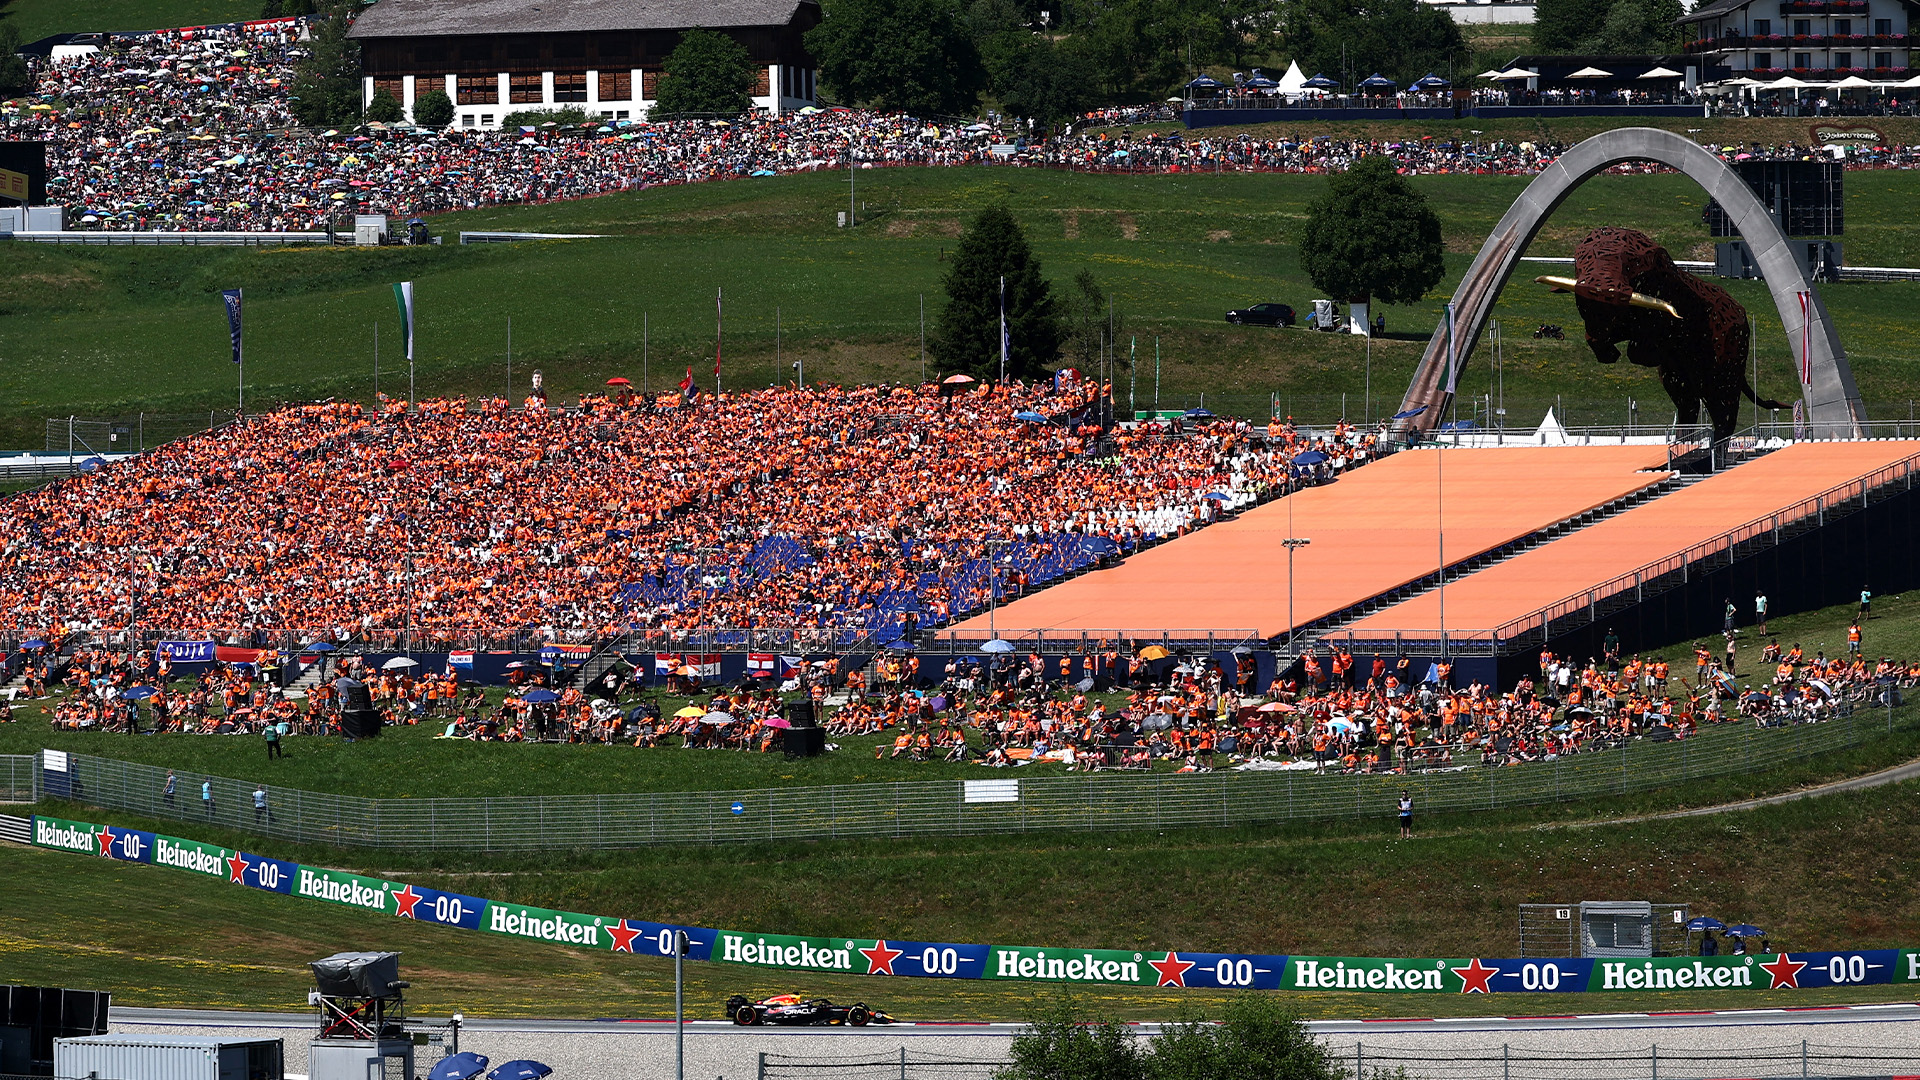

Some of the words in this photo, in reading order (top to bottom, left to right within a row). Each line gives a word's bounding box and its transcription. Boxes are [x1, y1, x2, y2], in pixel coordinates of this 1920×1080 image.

[37, 820, 93, 851] Heineken
[157, 839, 223, 875] Heineken
[299, 870, 385, 909] Heineken
[490, 905, 598, 945] Heineken
[1558, 910, 1568, 918] 19
[723, 935, 851, 969] Heineken
[997, 951, 1140, 981] Heineken
[1295, 961, 1443, 989] Heineken
[1603, 962, 1752, 988] Heineken
